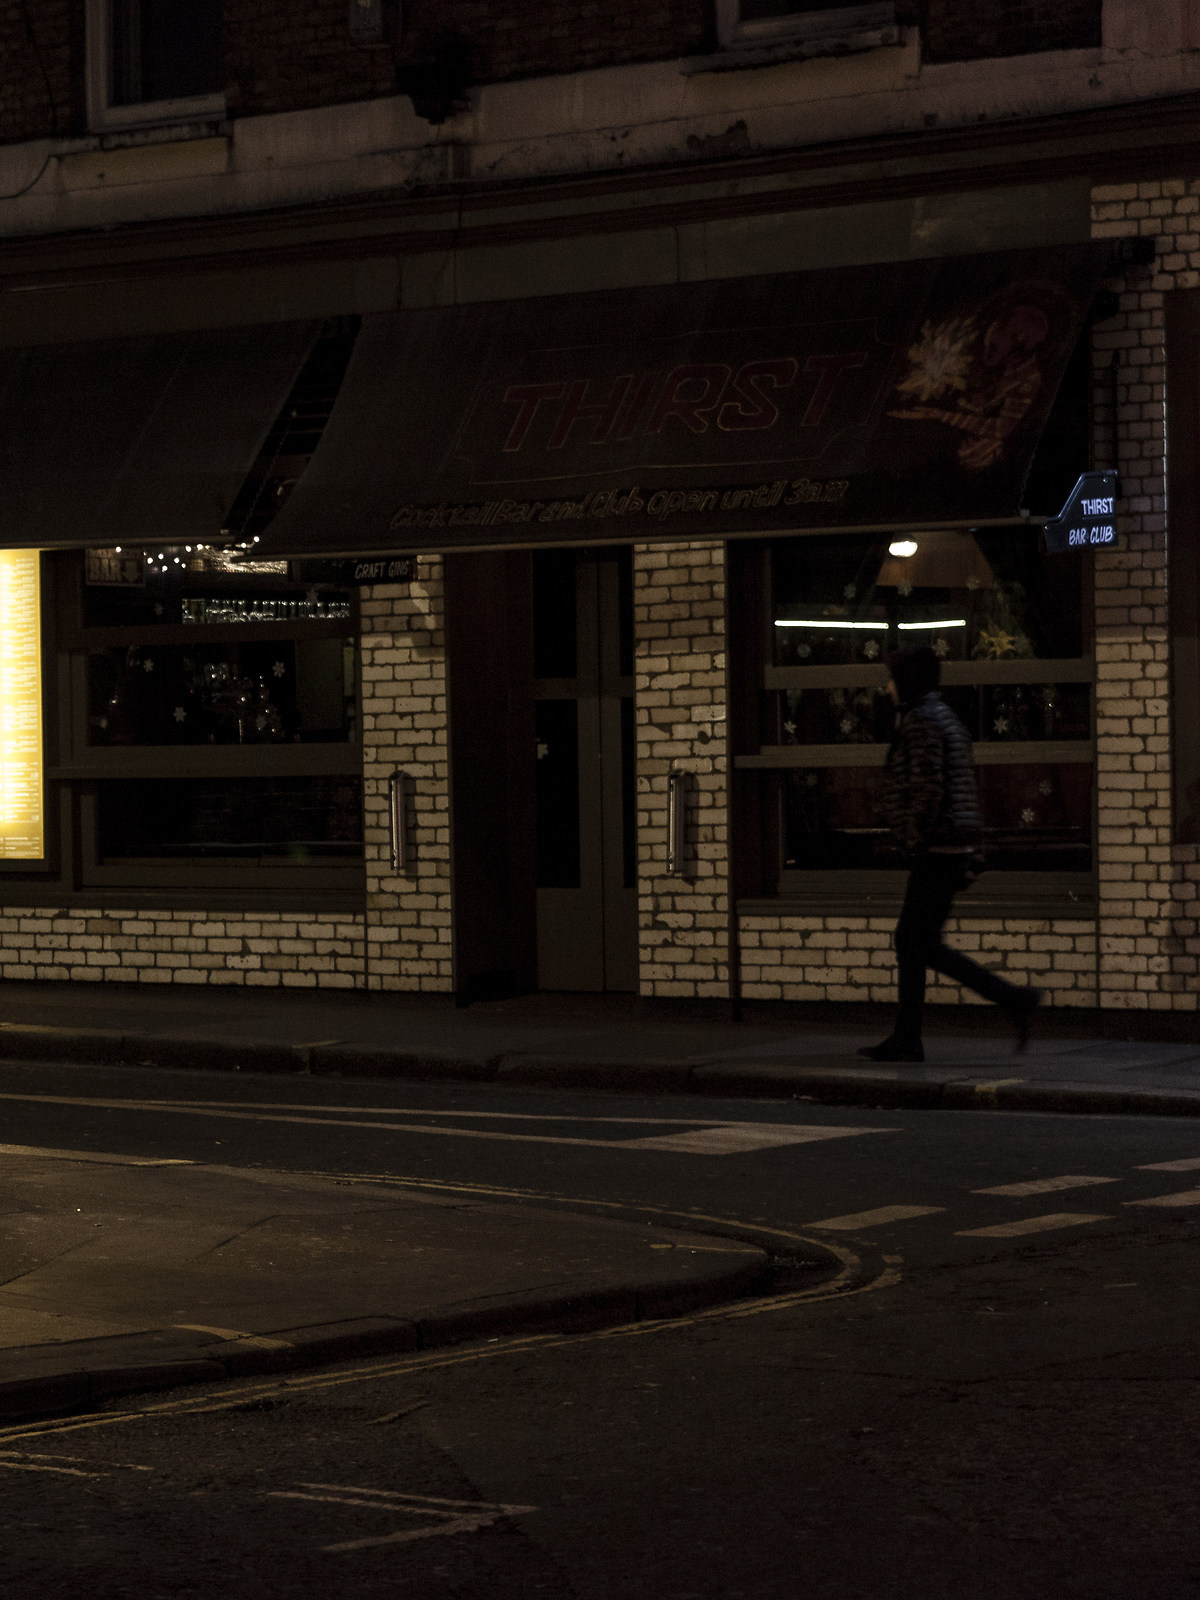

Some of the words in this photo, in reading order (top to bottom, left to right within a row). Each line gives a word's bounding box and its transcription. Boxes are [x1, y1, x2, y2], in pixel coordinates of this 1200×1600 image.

[502, 352, 869, 453] THIRST
[720, 479, 787, 510] until
[1081, 497, 1113, 515] THIRST
[1068, 528, 1088, 546] BAR
[1090, 525, 1114, 545] CLUB
[354, 561, 387, 580] CRAFT
